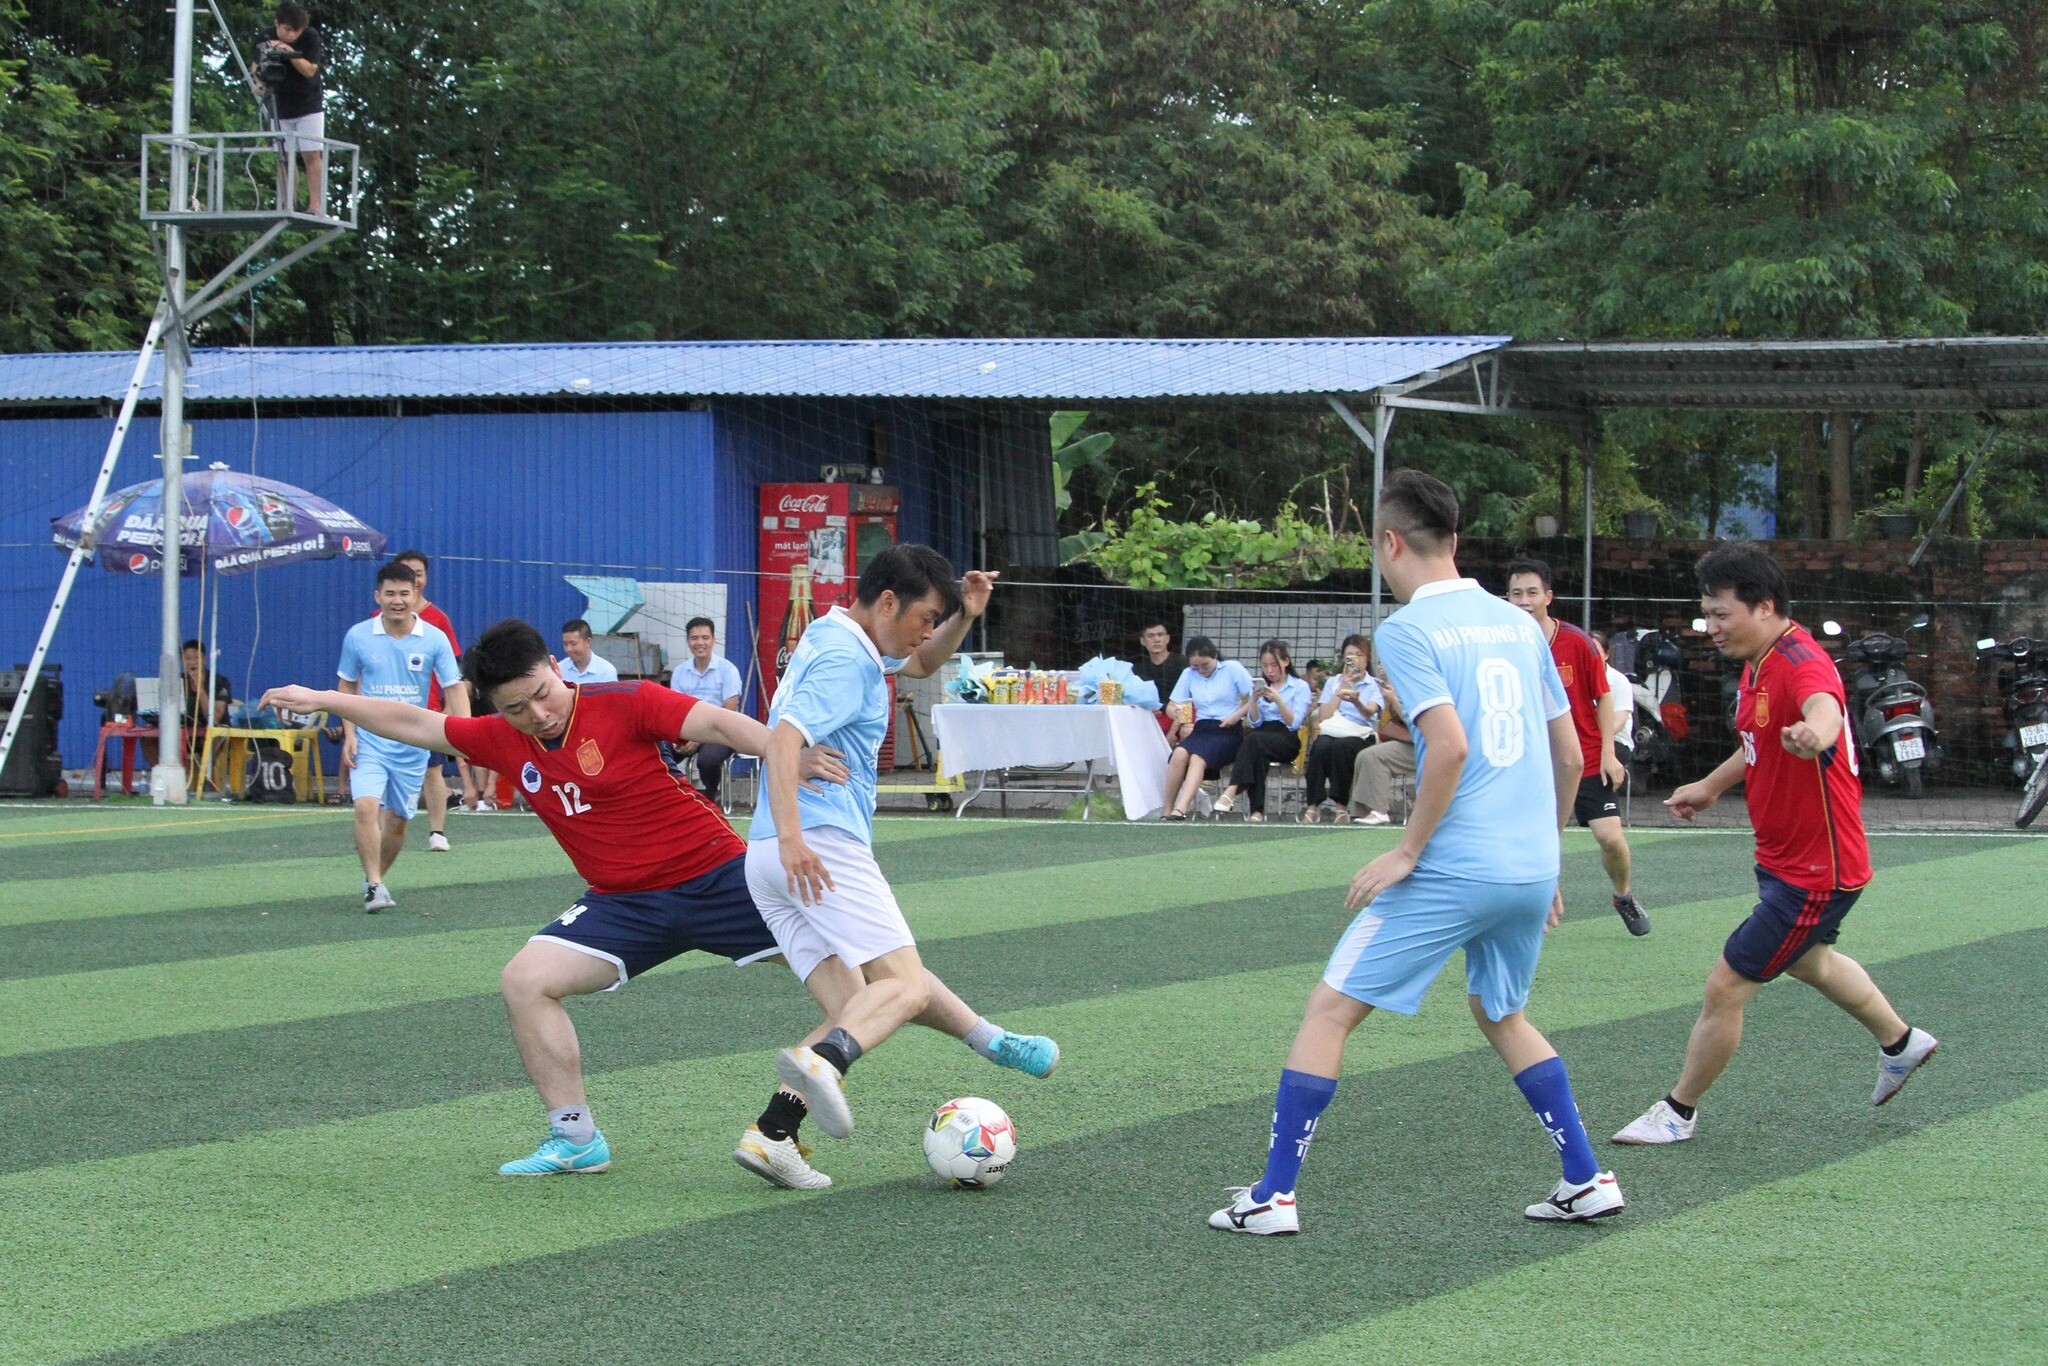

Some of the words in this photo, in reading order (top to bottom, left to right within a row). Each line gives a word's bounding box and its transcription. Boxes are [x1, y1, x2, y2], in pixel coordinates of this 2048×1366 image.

[779, 494, 828, 513] Coca-Cola
[775, 541, 791, 550] mát
[1431, 627, 1462, 649] HAI
[1476, 657, 1525, 768] 8
[261, 761, 287, 791] 10
[551, 781, 592, 817] 12
